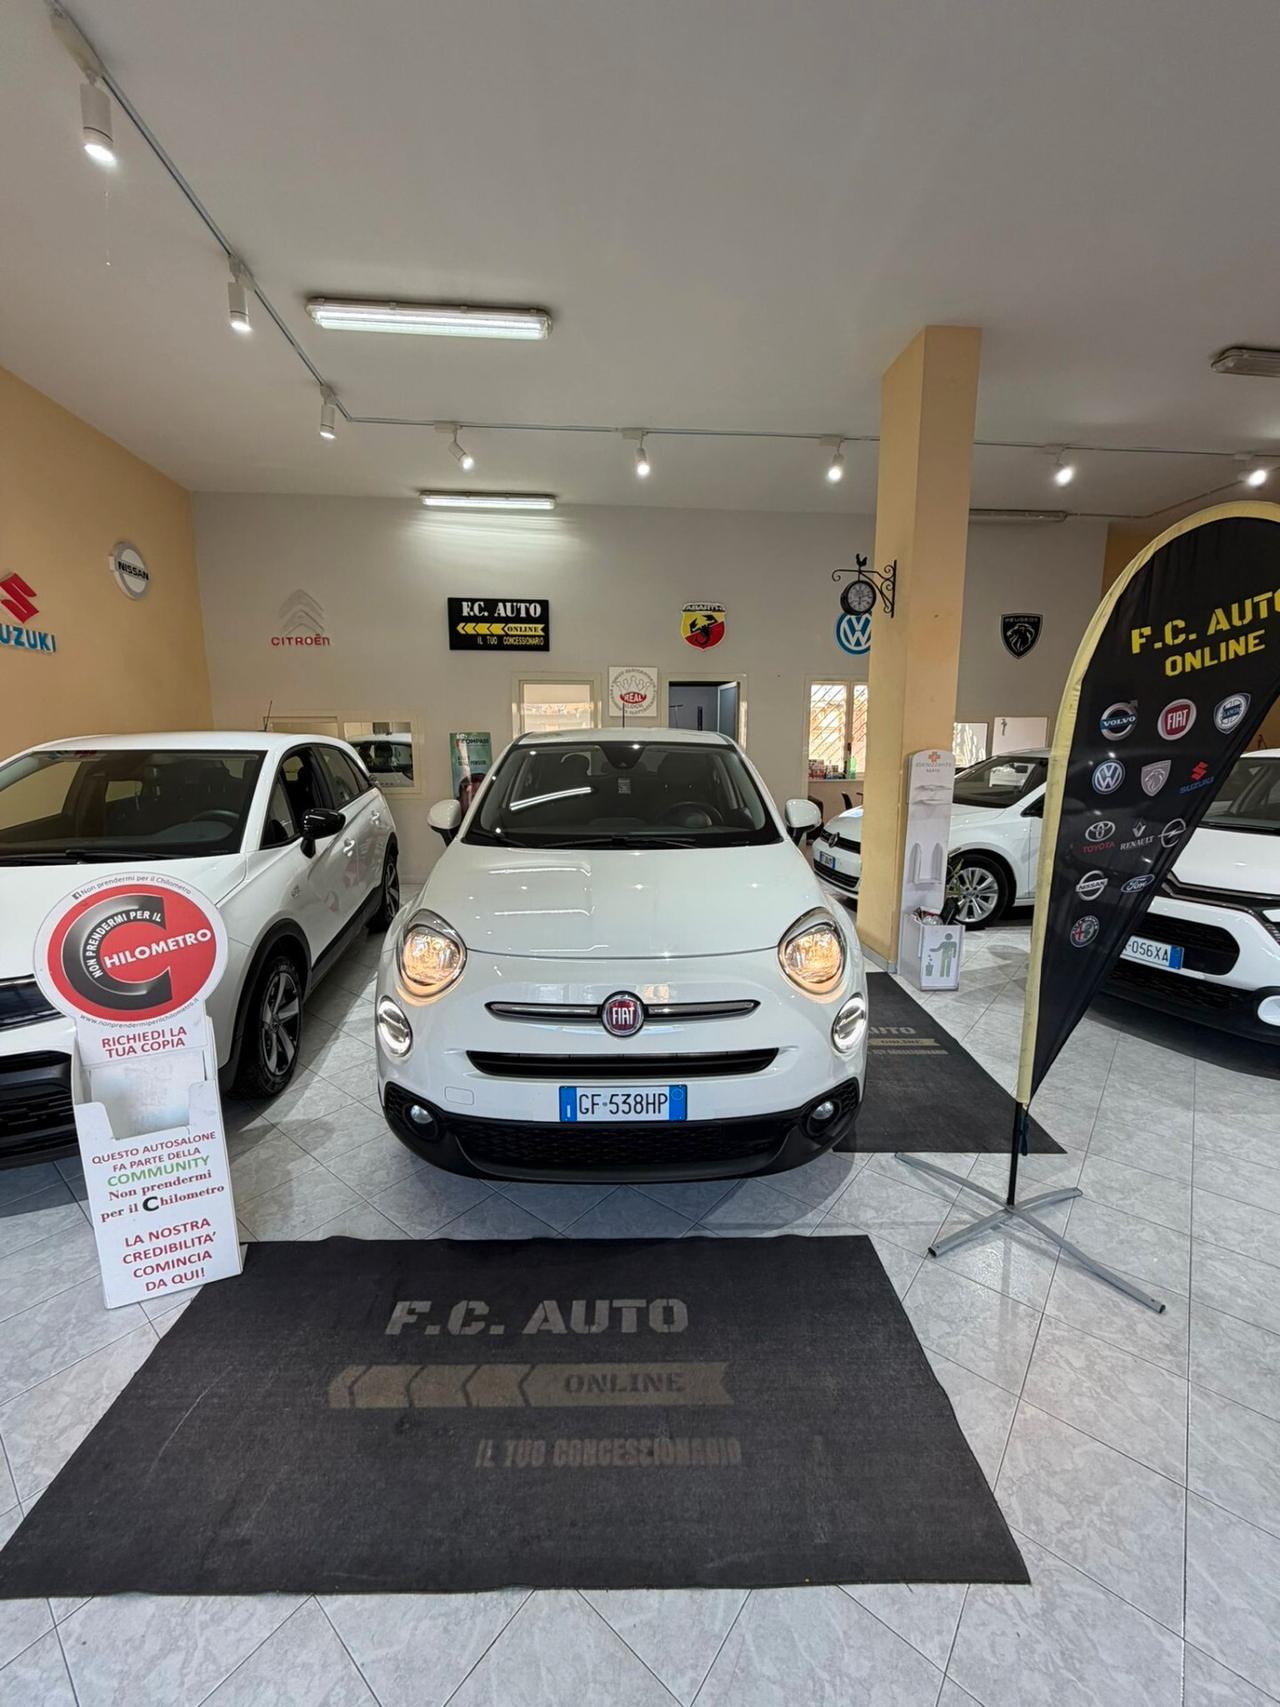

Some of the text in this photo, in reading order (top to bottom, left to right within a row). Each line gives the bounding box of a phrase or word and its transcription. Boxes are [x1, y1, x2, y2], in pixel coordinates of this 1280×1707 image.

[117, 560, 150, 581] NISSAN
[494, 602, 541, 618] AUTO
[0, 623, 57, 653] UZUKI
[507, 625, 540, 633] ONLINE
[1131, 619, 1197, 654] F.C.
[1165, 629, 1266, 677] ONLINE
[1103, 715, 1136, 727] VOLVO
[1166, 708, 1189, 730] FIAT
[1179, 776, 1214, 794] SUZUKI
[1083, 841, 1115, 853] TOYOTA
[1120, 836, 1154, 850] RENAULT
[80, 884, 97, 896] Non
[1079, 879, 1106, 890] NISSAN
[86, 911, 162, 979] NON PRENDERMI PER IL
[612, 1007, 634, 1025] FIAT
[101, 1025, 188, 1049] RICHIEDI LA
[105, 1037, 186, 1059] TUA COPIA
[92, 1131, 217, 1164] QUESTO AUTOSALONE
[112, 1147, 201, 1173] FA PARTE DELLA
[107, 1155, 210, 1187] COMMUNITY
[108, 1169, 213, 1201] Non prendermi
[100, 1185, 225, 1223] per il Chilometro
[124, 1217, 212, 1248] LA NOSTRA
[122, 1231, 217, 1265] CREDIBILITA'
[133, 1250, 213, 1279] COMINCIA
[145, 1267, 206, 1292] DA QUI!
[384, 1298, 690, 1336] F.C. AUTO
[564, 1372, 685, 1394] ONLINE
[504, 1440, 547, 1468] TUO
